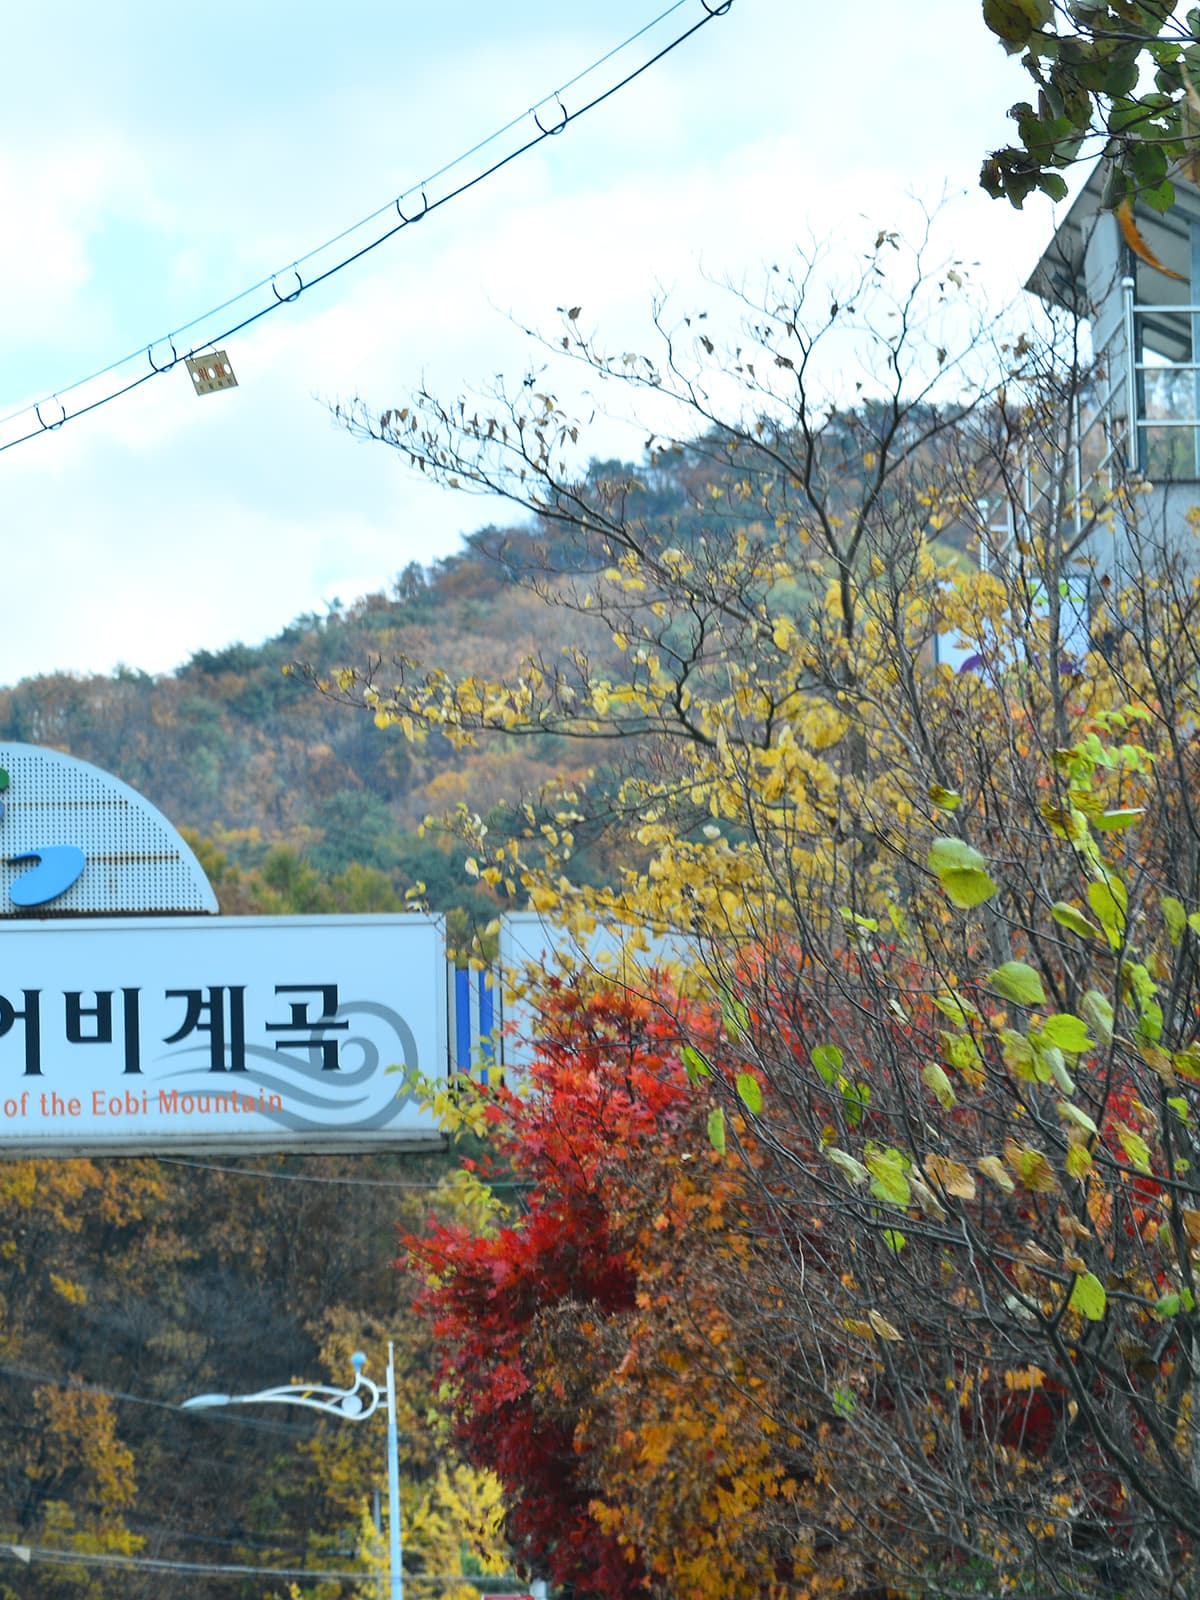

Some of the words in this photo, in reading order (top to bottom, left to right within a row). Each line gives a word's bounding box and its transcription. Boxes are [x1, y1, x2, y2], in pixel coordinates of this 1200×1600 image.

[3, 1091, 30, 1118] of
[39, 1091, 82, 1118] the
[91, 1090, 148, 1117] Eobi
[158, 1087, 284, 1115] Mountain
